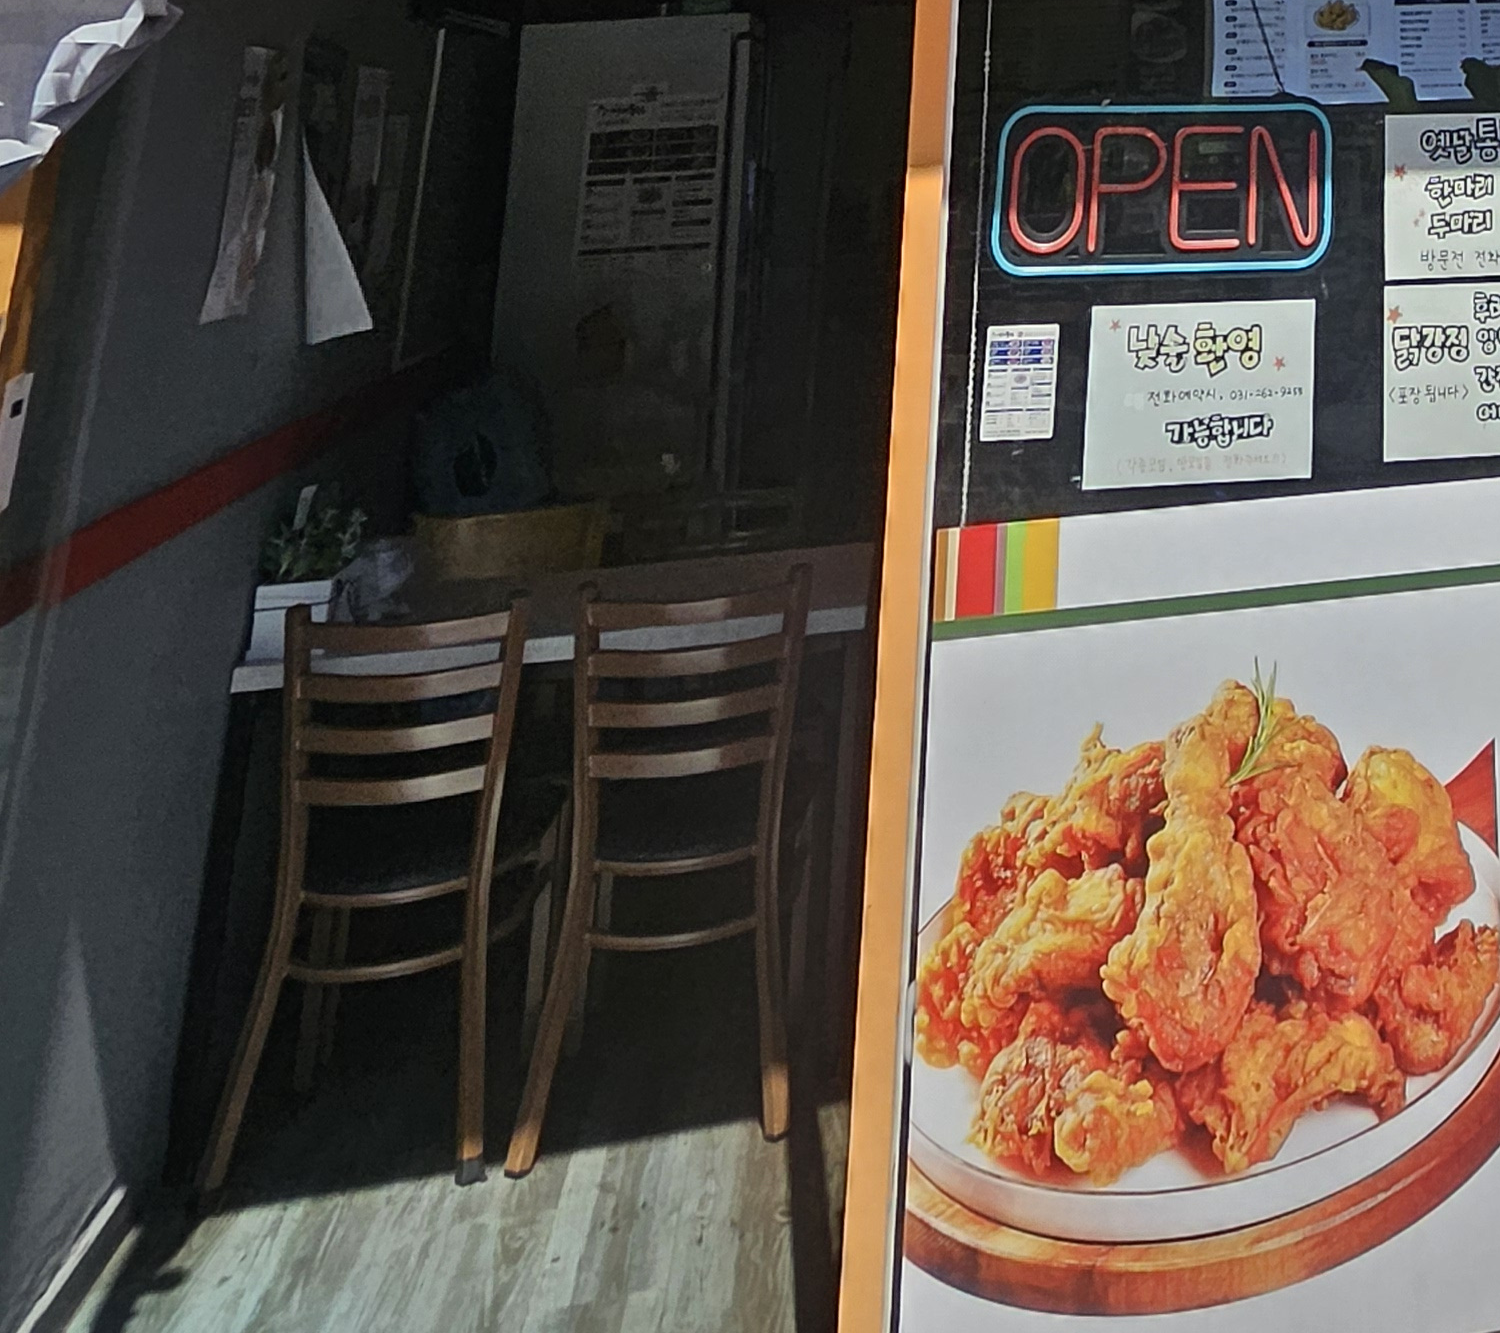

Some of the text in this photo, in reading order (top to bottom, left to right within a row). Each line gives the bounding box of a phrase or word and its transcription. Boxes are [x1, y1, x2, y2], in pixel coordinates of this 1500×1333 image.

[1007, 125, 1319, 255] OPEN
[1424, 172, 1495, 209] 한마리
[1427, 208, 1494, 240] 두마리
[1419, 249, 1464, 272] 방문전
[1391, 324, 1471, 372] 닭강정
[1164, 413, 1275, 449] 가능합니다
